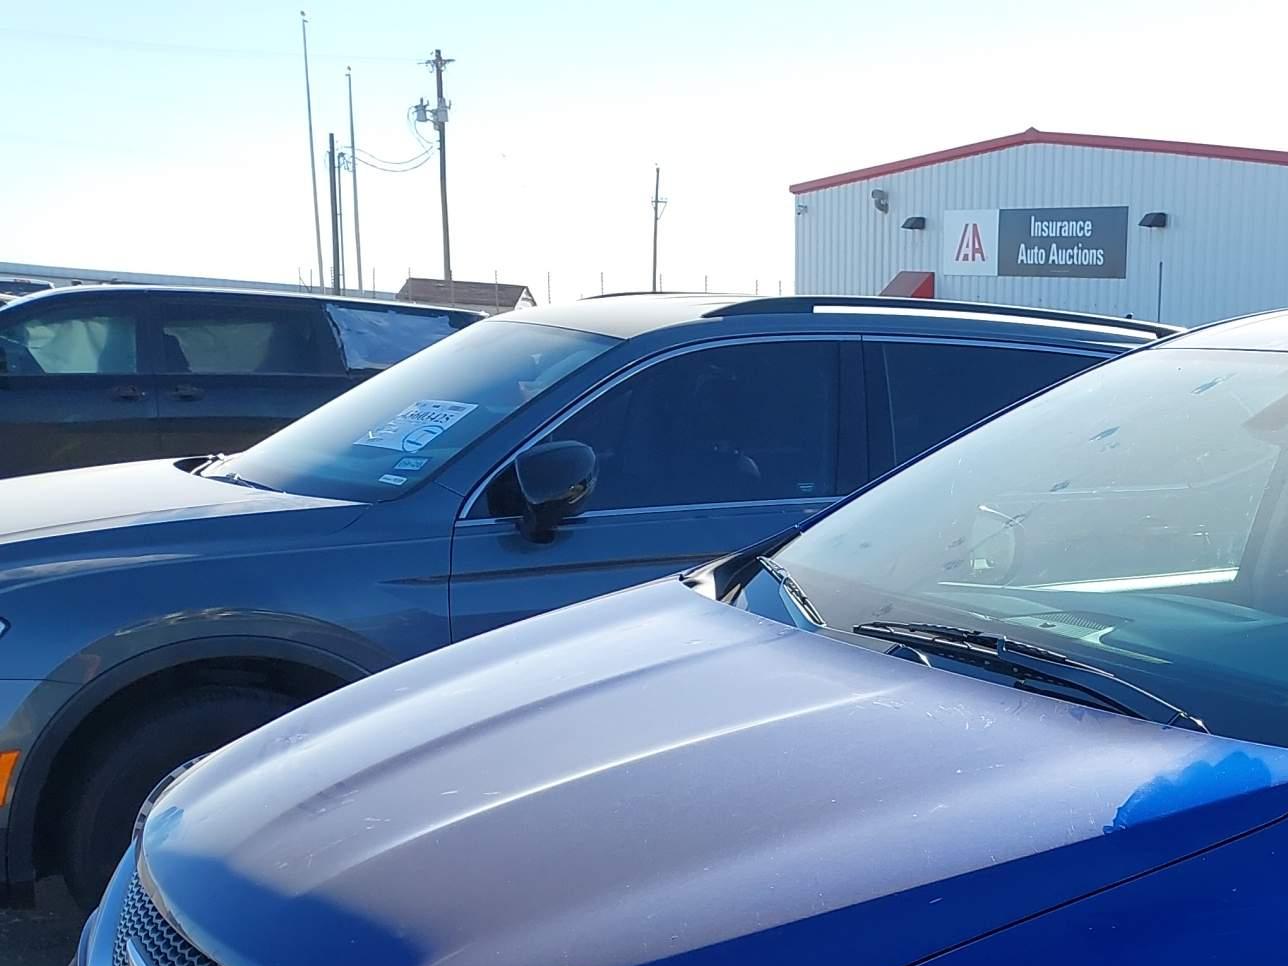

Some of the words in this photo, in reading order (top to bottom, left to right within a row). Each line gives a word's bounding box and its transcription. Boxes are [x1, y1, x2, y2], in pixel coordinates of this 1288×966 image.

[1030, 216, 1092, 237] Insurance
[1017, 243, 1045, 265] Auto
[1049, 243, 1104, 266] Auctions
